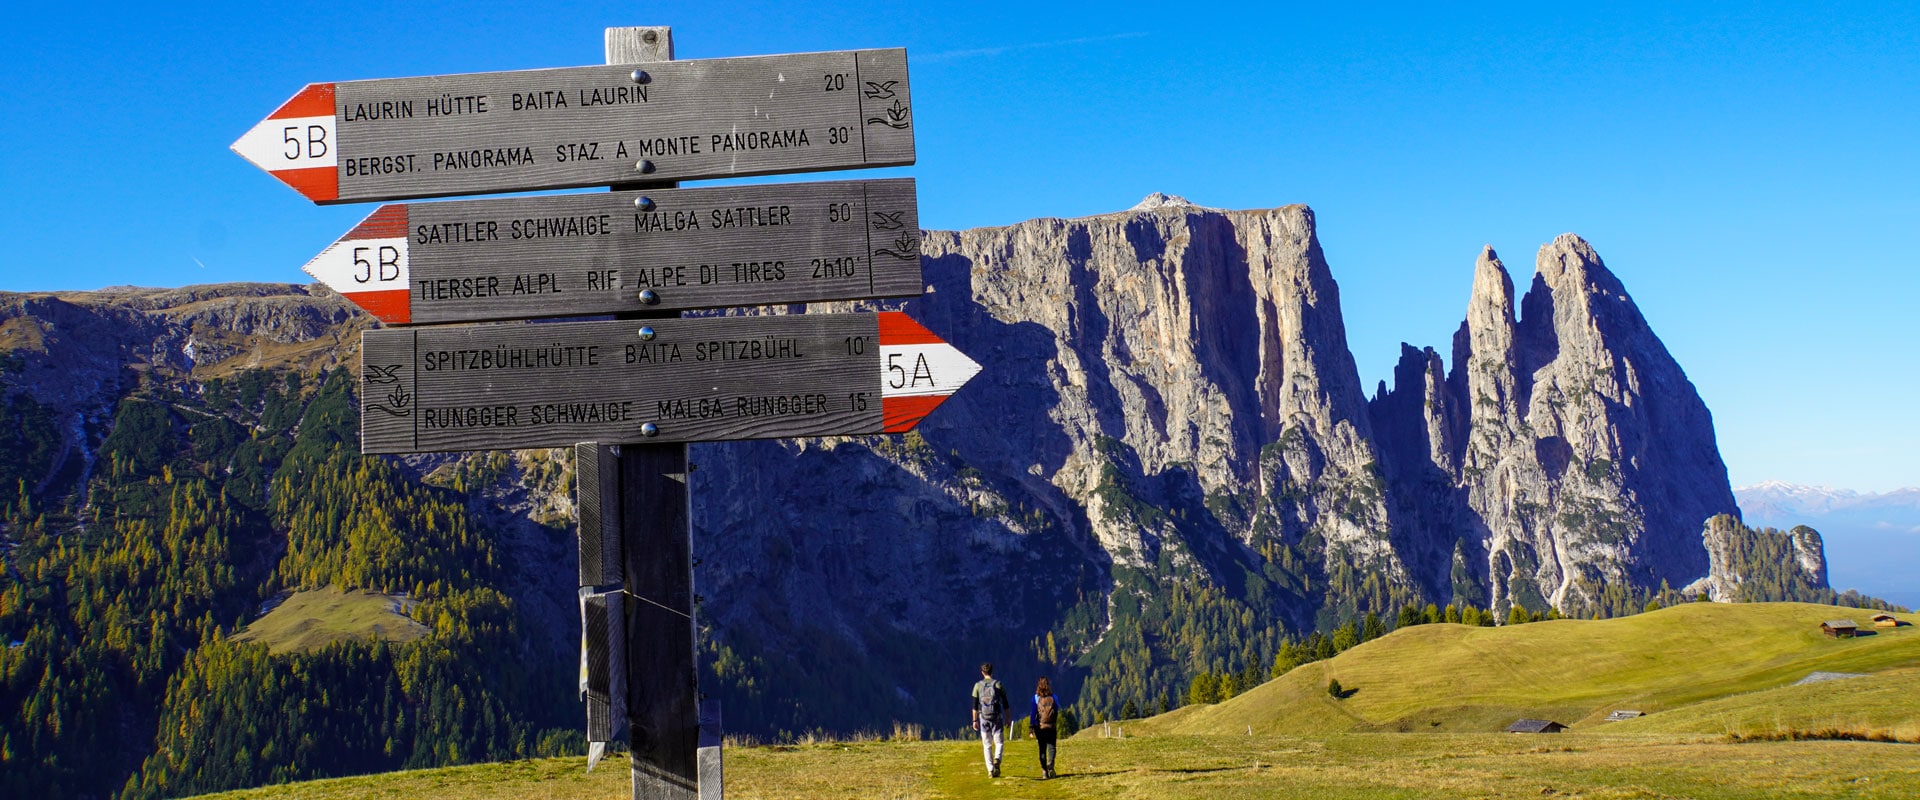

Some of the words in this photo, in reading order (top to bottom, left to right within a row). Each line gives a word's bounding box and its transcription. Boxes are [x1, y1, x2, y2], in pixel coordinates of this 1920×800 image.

[344, 101, 413, 122] LAURIN
[427, 94, 488, 117] HÜTTE
[512, 90, 567, 111] BAITA
[580, 86, 648, 106] LAURIN
[284, 125, 328, 161] 5B
[346, 154, 422, 177] BERGST.
[434, 147, 534, 171] PANORAMA
[556, 142, 604, 163] STAZ.
[616, 140, 629, 159] A
[639, 135, 700, 156] MONTE
[712, 129, 810, 153] PANORAMA
[417, 221, 499, 245] SATTLER
[511, 214, 611, 240] SCHWAIGE
[635, 210, 699, 233] MALGA
[711, 205, 790, 229] SATTLER
[354, 246, 400, 284] 5B
[419, 275, 500, 301] TIERSER
[512, 273, 562, 295] ALPL
[588, 270, 624, 291] RIF.
[637, 265, 686, 289] ALPE
[700, 264, 718, 285] DI
[731, 261, 786, 284] TIRES
[425, 342, 599, 371] SPITZBÜHLHÜTTE
[625, 343, 682, 364] BAITA
[696, 335, 803, 361] SPITZBÜHL
[888, 352, 935, 389] 5A
[425, 404, 518, 429] RUNGGER
[531, 401, 633, 425] SCHWAIGE
[658, 397, 724, 420] MALGA
[737, 394, 827, 417] RUNGGER
